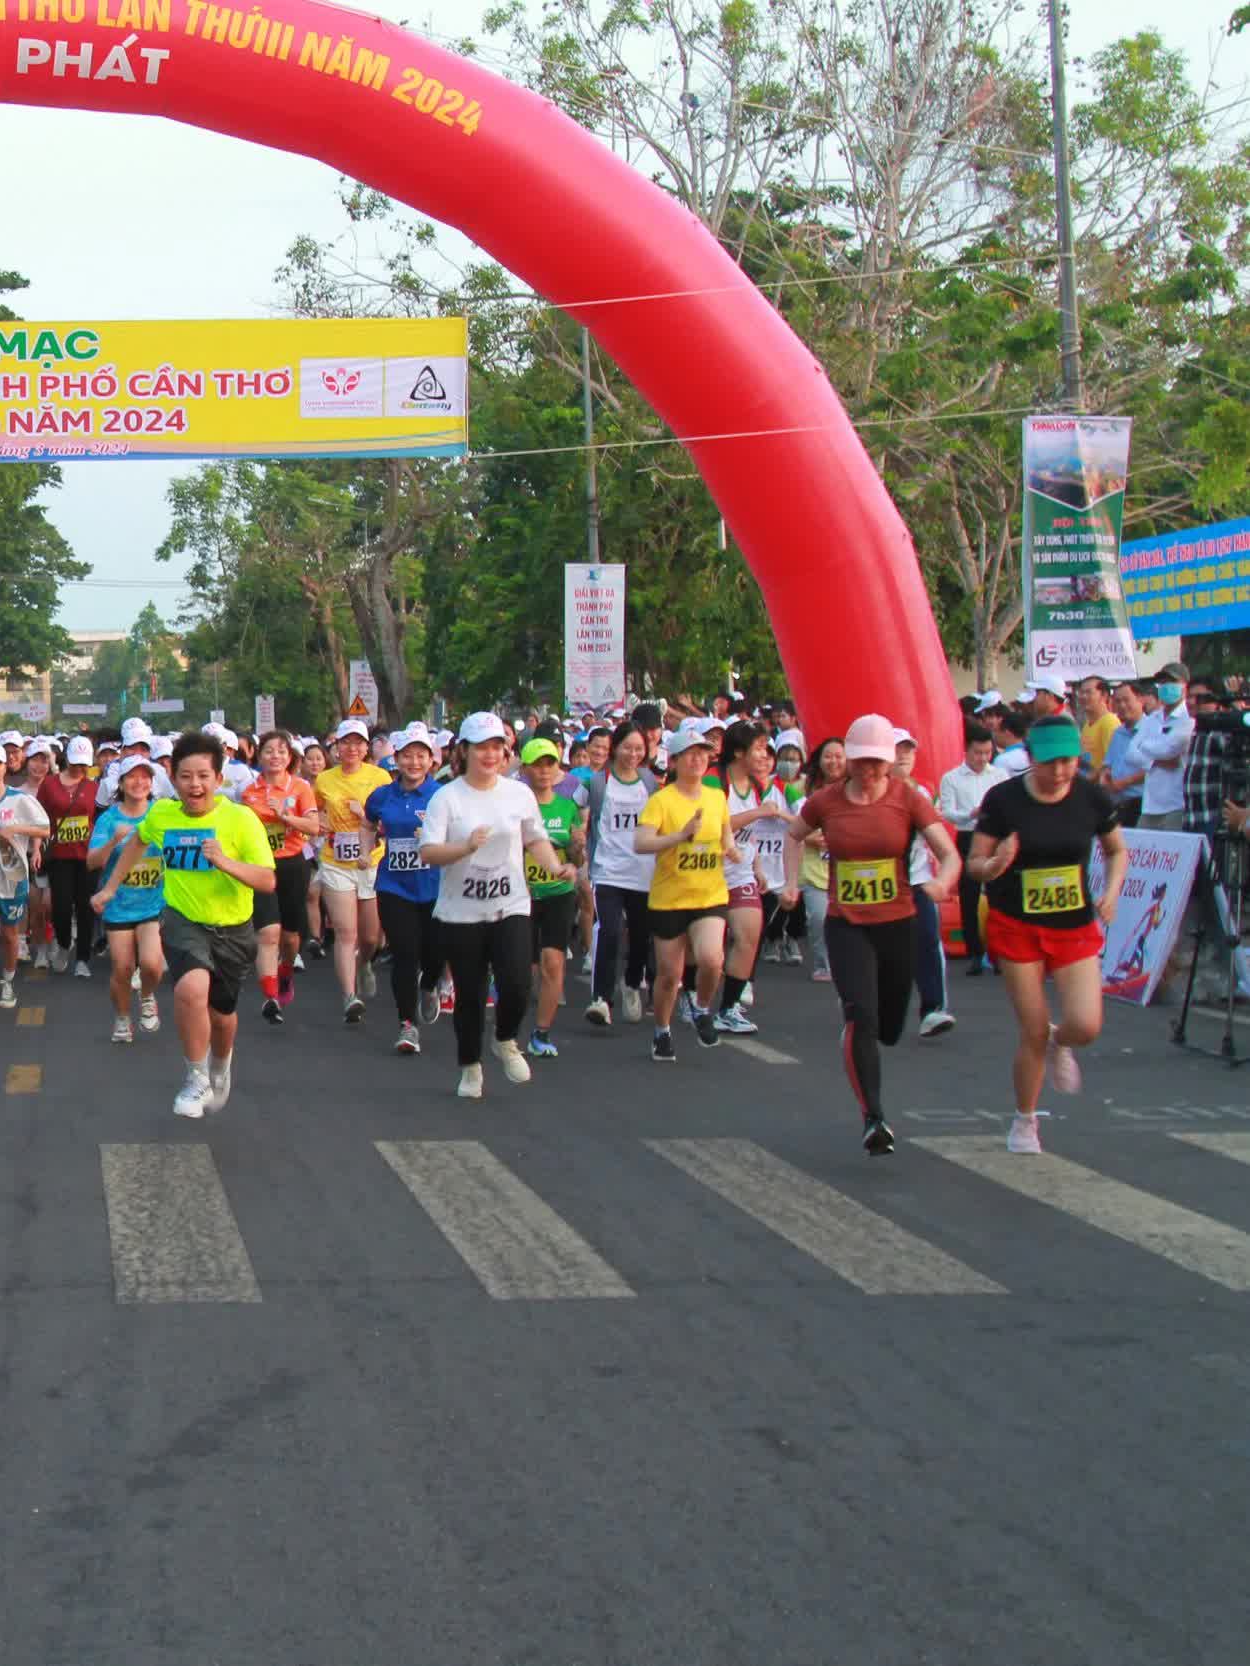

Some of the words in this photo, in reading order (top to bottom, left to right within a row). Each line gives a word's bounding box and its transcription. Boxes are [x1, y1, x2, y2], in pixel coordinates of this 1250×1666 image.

[16, 33, 170, 84] PHÁT
[298, 35, 391, 91] NĂM
[391, 68, 484, 136] 2024
[40, 365, 121, 398] PHỐ
[128, 364, 202, 397] CẦN
[213, 369, 291, 397] THƠ
[8, 405, 91, 435] NĂM
[101, 409, 187, 434] 2024
[47, 441, 86, 456] năm
[390, 851, 428, 869] 282
[462, 876, 511, 900] 2826
[841, 877, 895, 903] 2419
